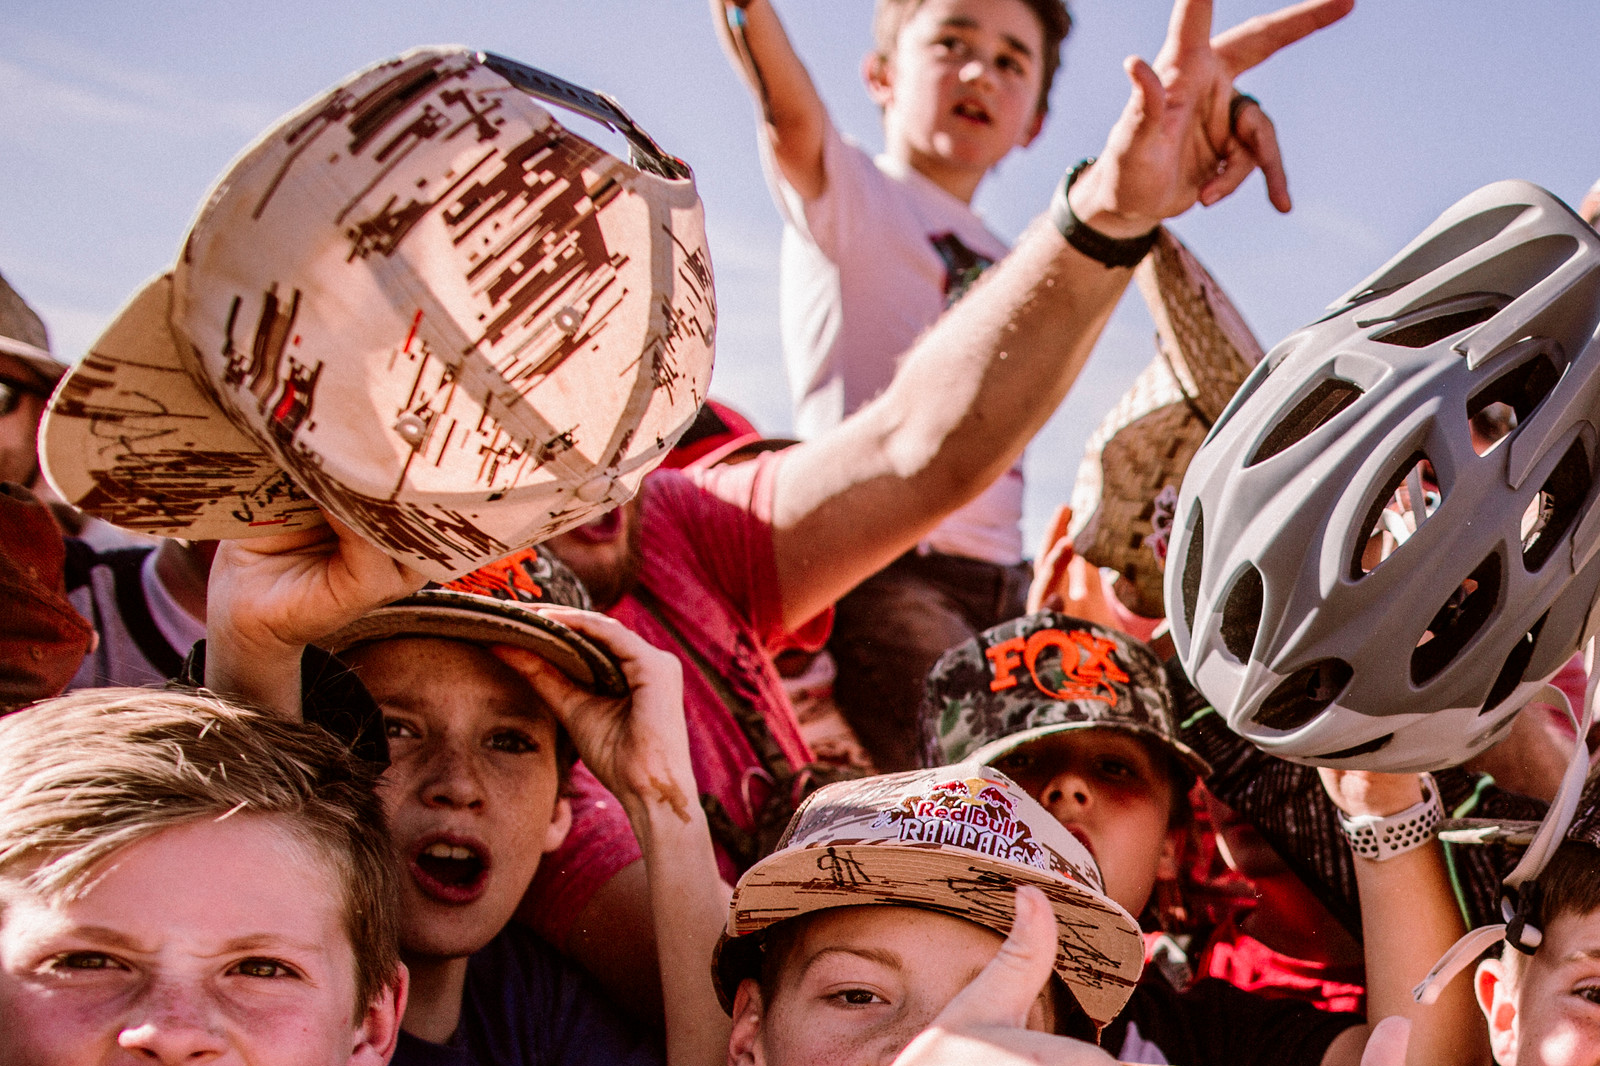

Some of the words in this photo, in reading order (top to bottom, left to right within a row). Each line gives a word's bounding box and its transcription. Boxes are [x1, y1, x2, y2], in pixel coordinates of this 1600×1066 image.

[985, 628, 1131, 708] FOX
[899, 818, 1026, 864] RAMPAGE
[917, 802, 968, 822] Red
[971, 808, 1018, 841] Bull
